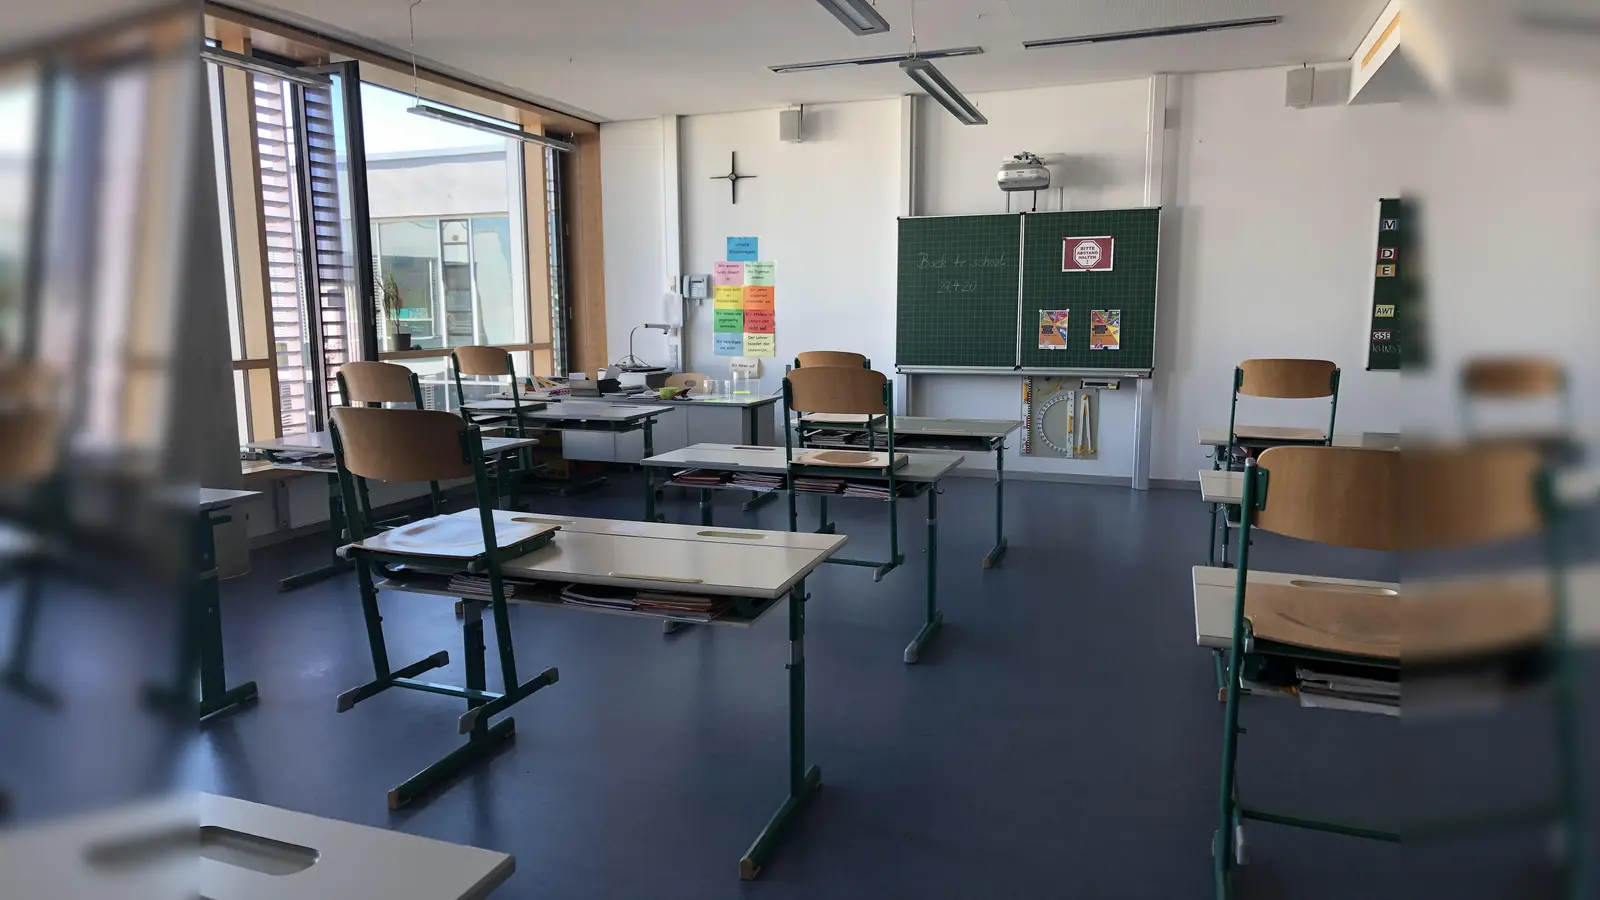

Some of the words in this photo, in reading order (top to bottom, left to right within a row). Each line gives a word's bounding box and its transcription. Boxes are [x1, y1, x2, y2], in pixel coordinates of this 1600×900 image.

[1383, 220, 1396, 230] M
[1381, 249, 1393, 258] D
[916, 252, 947, 268] Back
[969, 251, 1007, 267] school
[1381, 266, 1391, 275] E
[1376, 307, 1393, 315] AWT
[1373, 332, 1391, 340] GSE
